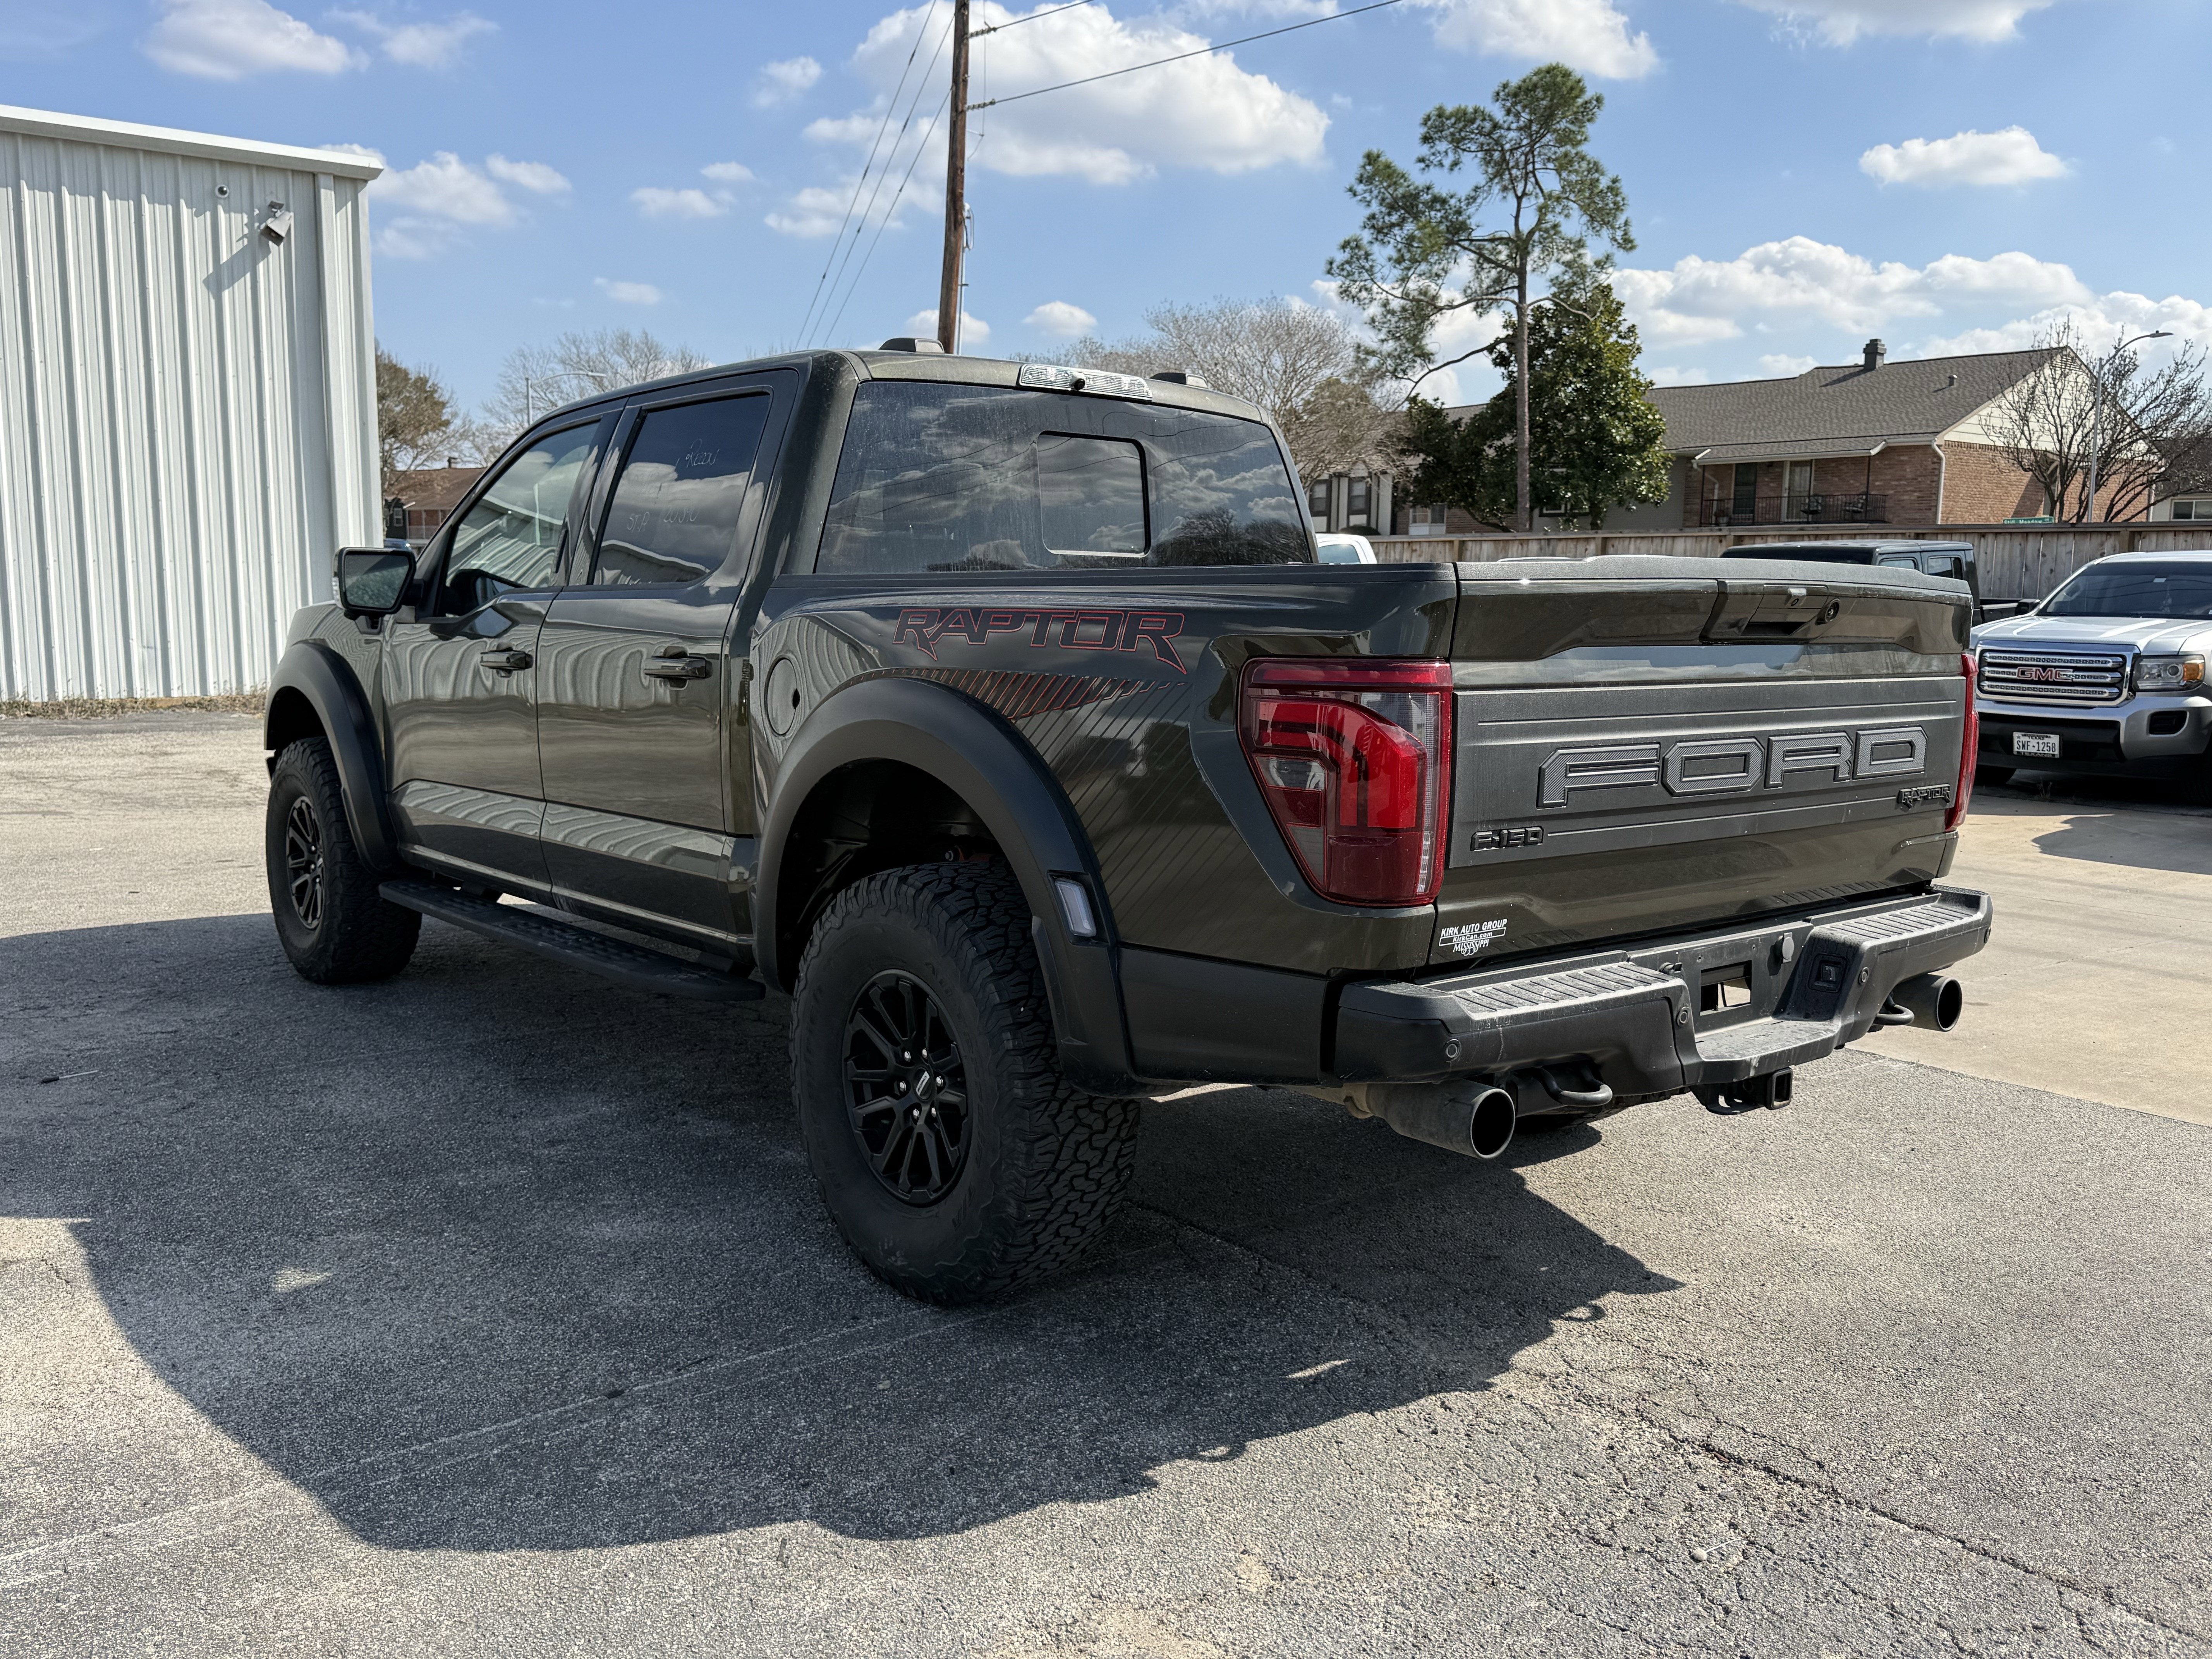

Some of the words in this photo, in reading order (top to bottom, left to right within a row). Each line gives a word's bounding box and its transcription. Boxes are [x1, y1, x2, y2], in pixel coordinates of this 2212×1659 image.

[892, 608, 1187, 675] RAPTOR
[2016, 666, 2073, 682] GMC
[1536, 725, 1928, 809] FORD
[1897, 783, 1950, 809] RAPTOR
[1470, 826, 1544, 852] F-150
[1441, 926, 1460, 937] KIRK
[1460, 923, 1480, 934] AUTO
[1482, 919, 1508, 930] GROUP
[1453, 932, 1492, 942] KirkCan.com
[1453, 939, 1489, 956] MISSISSIPPI
